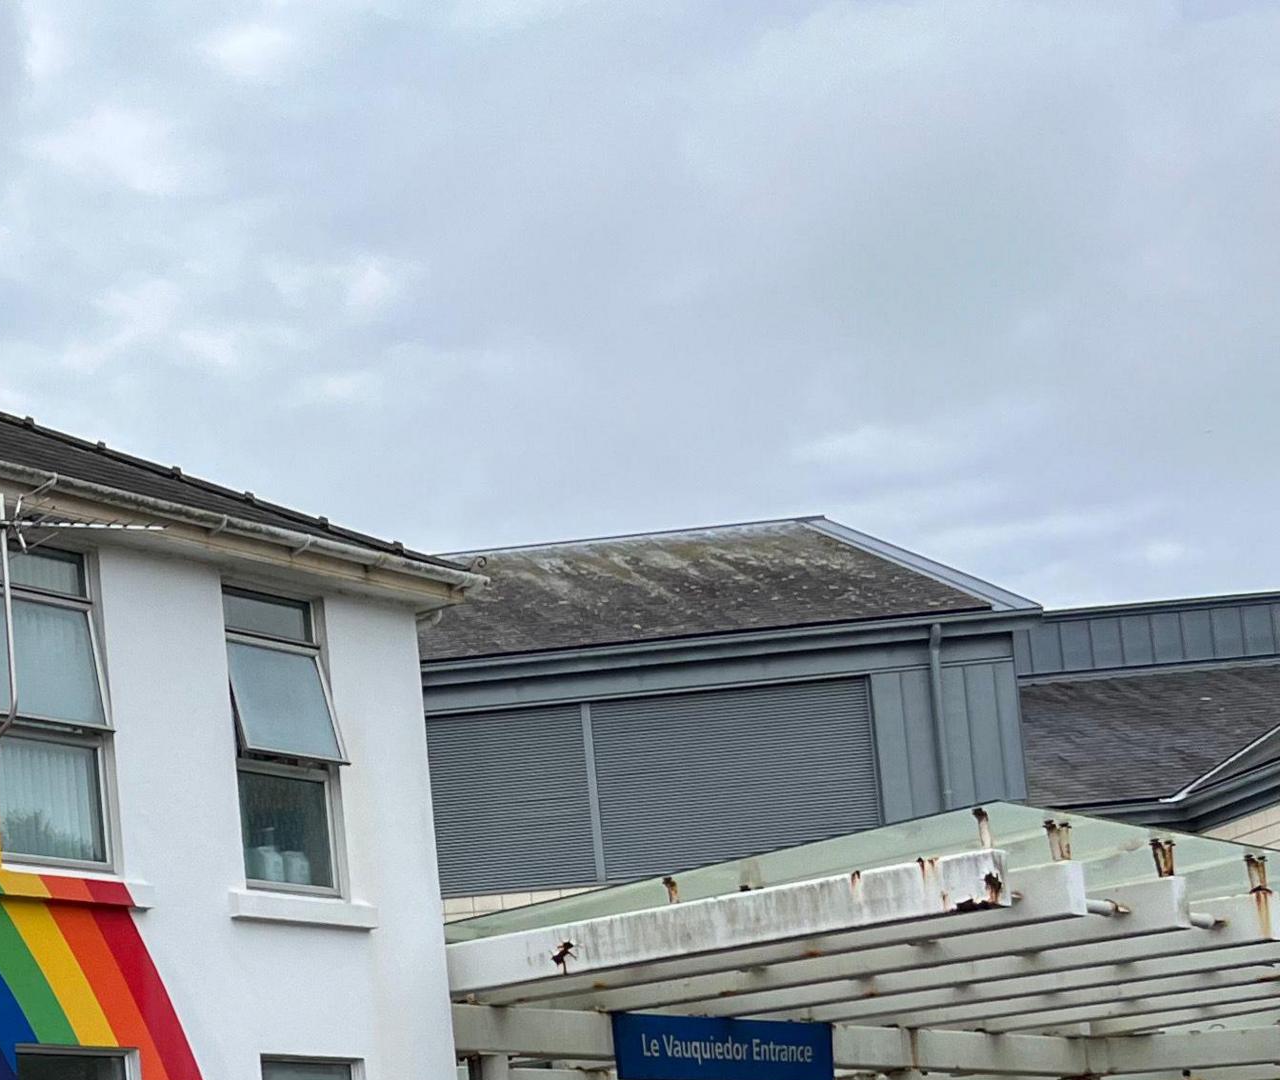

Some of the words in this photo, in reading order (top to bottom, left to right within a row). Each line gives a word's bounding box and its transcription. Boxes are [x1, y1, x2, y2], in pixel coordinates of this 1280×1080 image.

[641, 1033, 659, 1057] Le
[662, 1033, 748, 1065] Vauquiedor
[752, 1038, 813, 1062] Entrance
